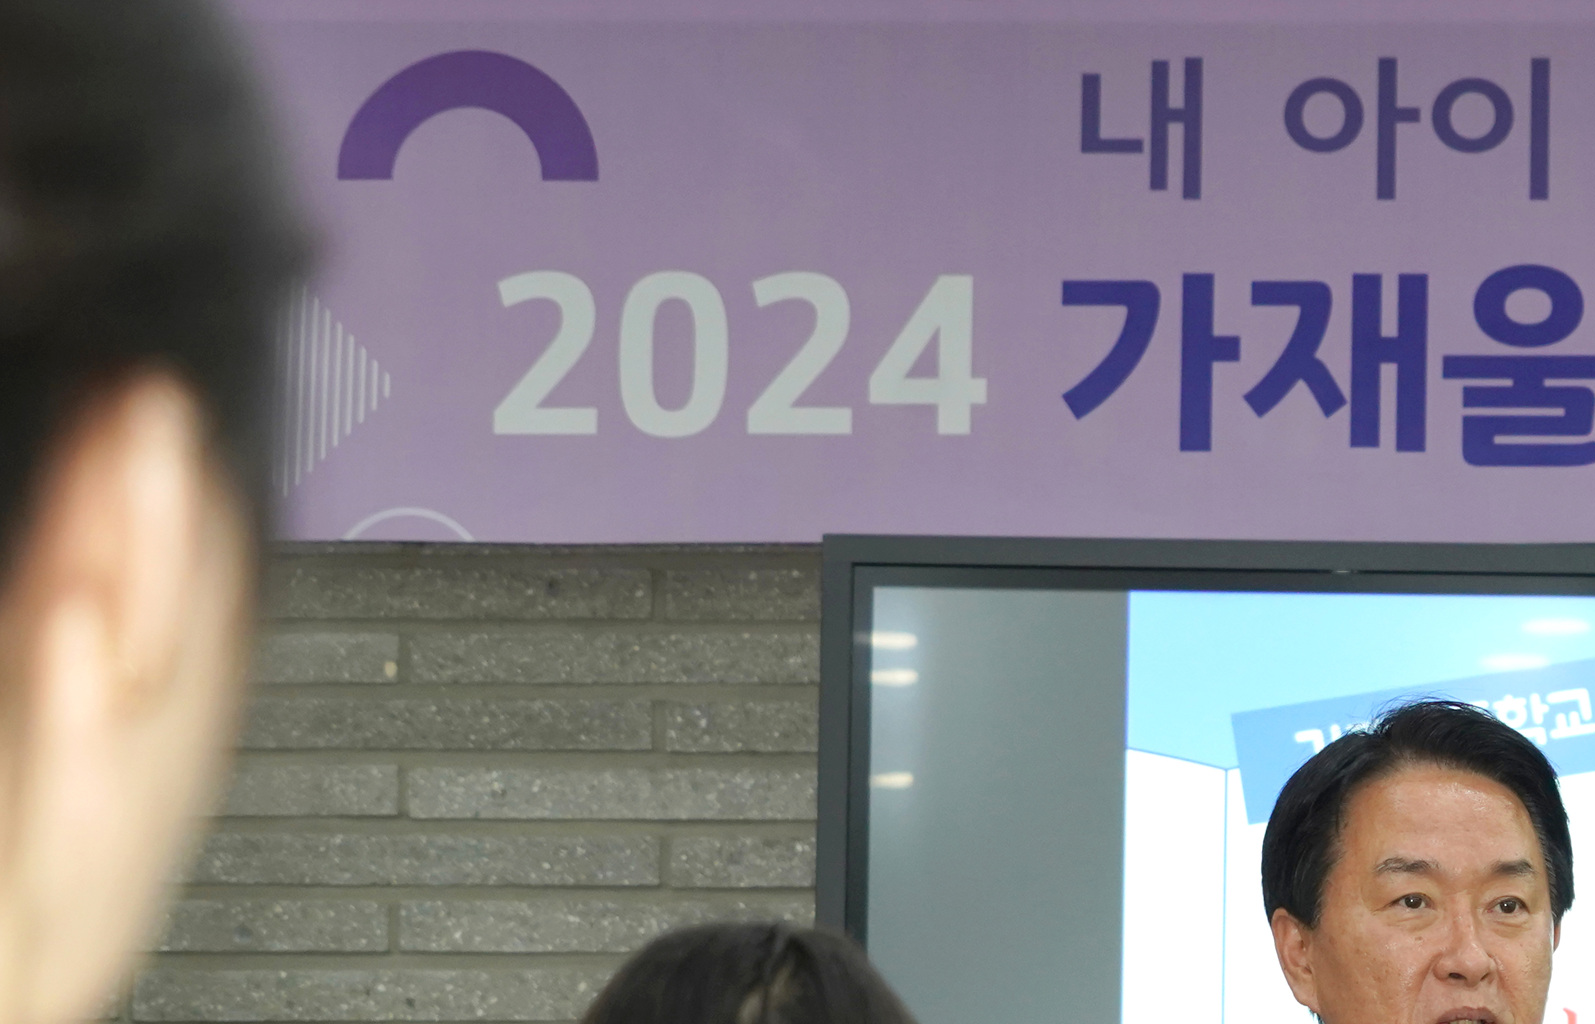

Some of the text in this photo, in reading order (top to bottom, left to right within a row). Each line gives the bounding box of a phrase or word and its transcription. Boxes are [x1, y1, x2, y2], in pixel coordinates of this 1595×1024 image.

[1080, 57, 1203, 201] 내
[1283, 57, 1550, 201] 아이
[492, 269, 988, 438] 2024
